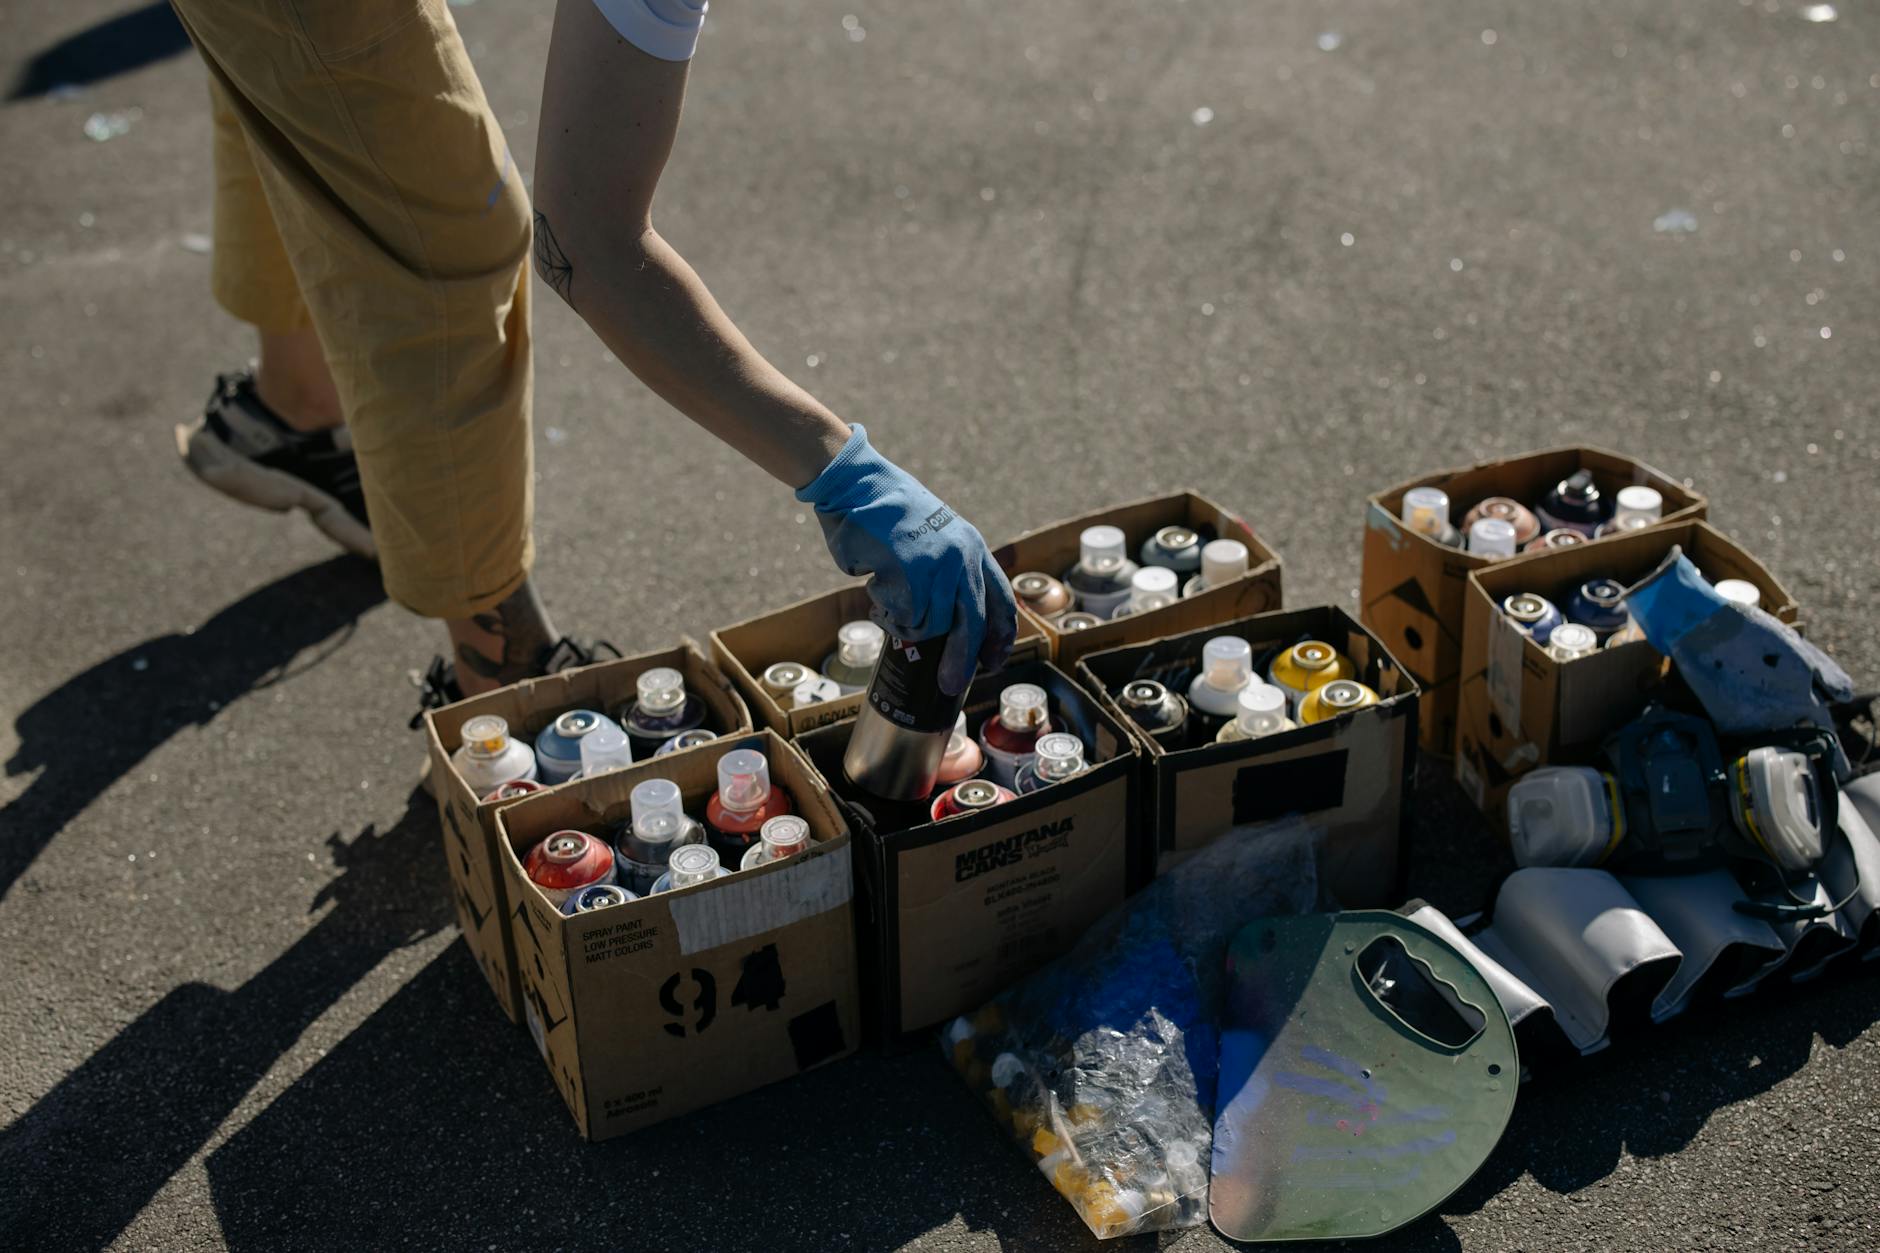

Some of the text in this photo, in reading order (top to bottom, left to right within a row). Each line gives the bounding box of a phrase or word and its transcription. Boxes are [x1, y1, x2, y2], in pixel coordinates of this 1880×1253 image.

[956, 817, 1073, 869] MONTANA
[955, 849, 1023, 882] CANS
[583, 919, 642, 941] SPRAY PAINT
[584, 927, 659, 953] LOW PRESSURE
[585, 940, 654, 964] MATT COLORS
